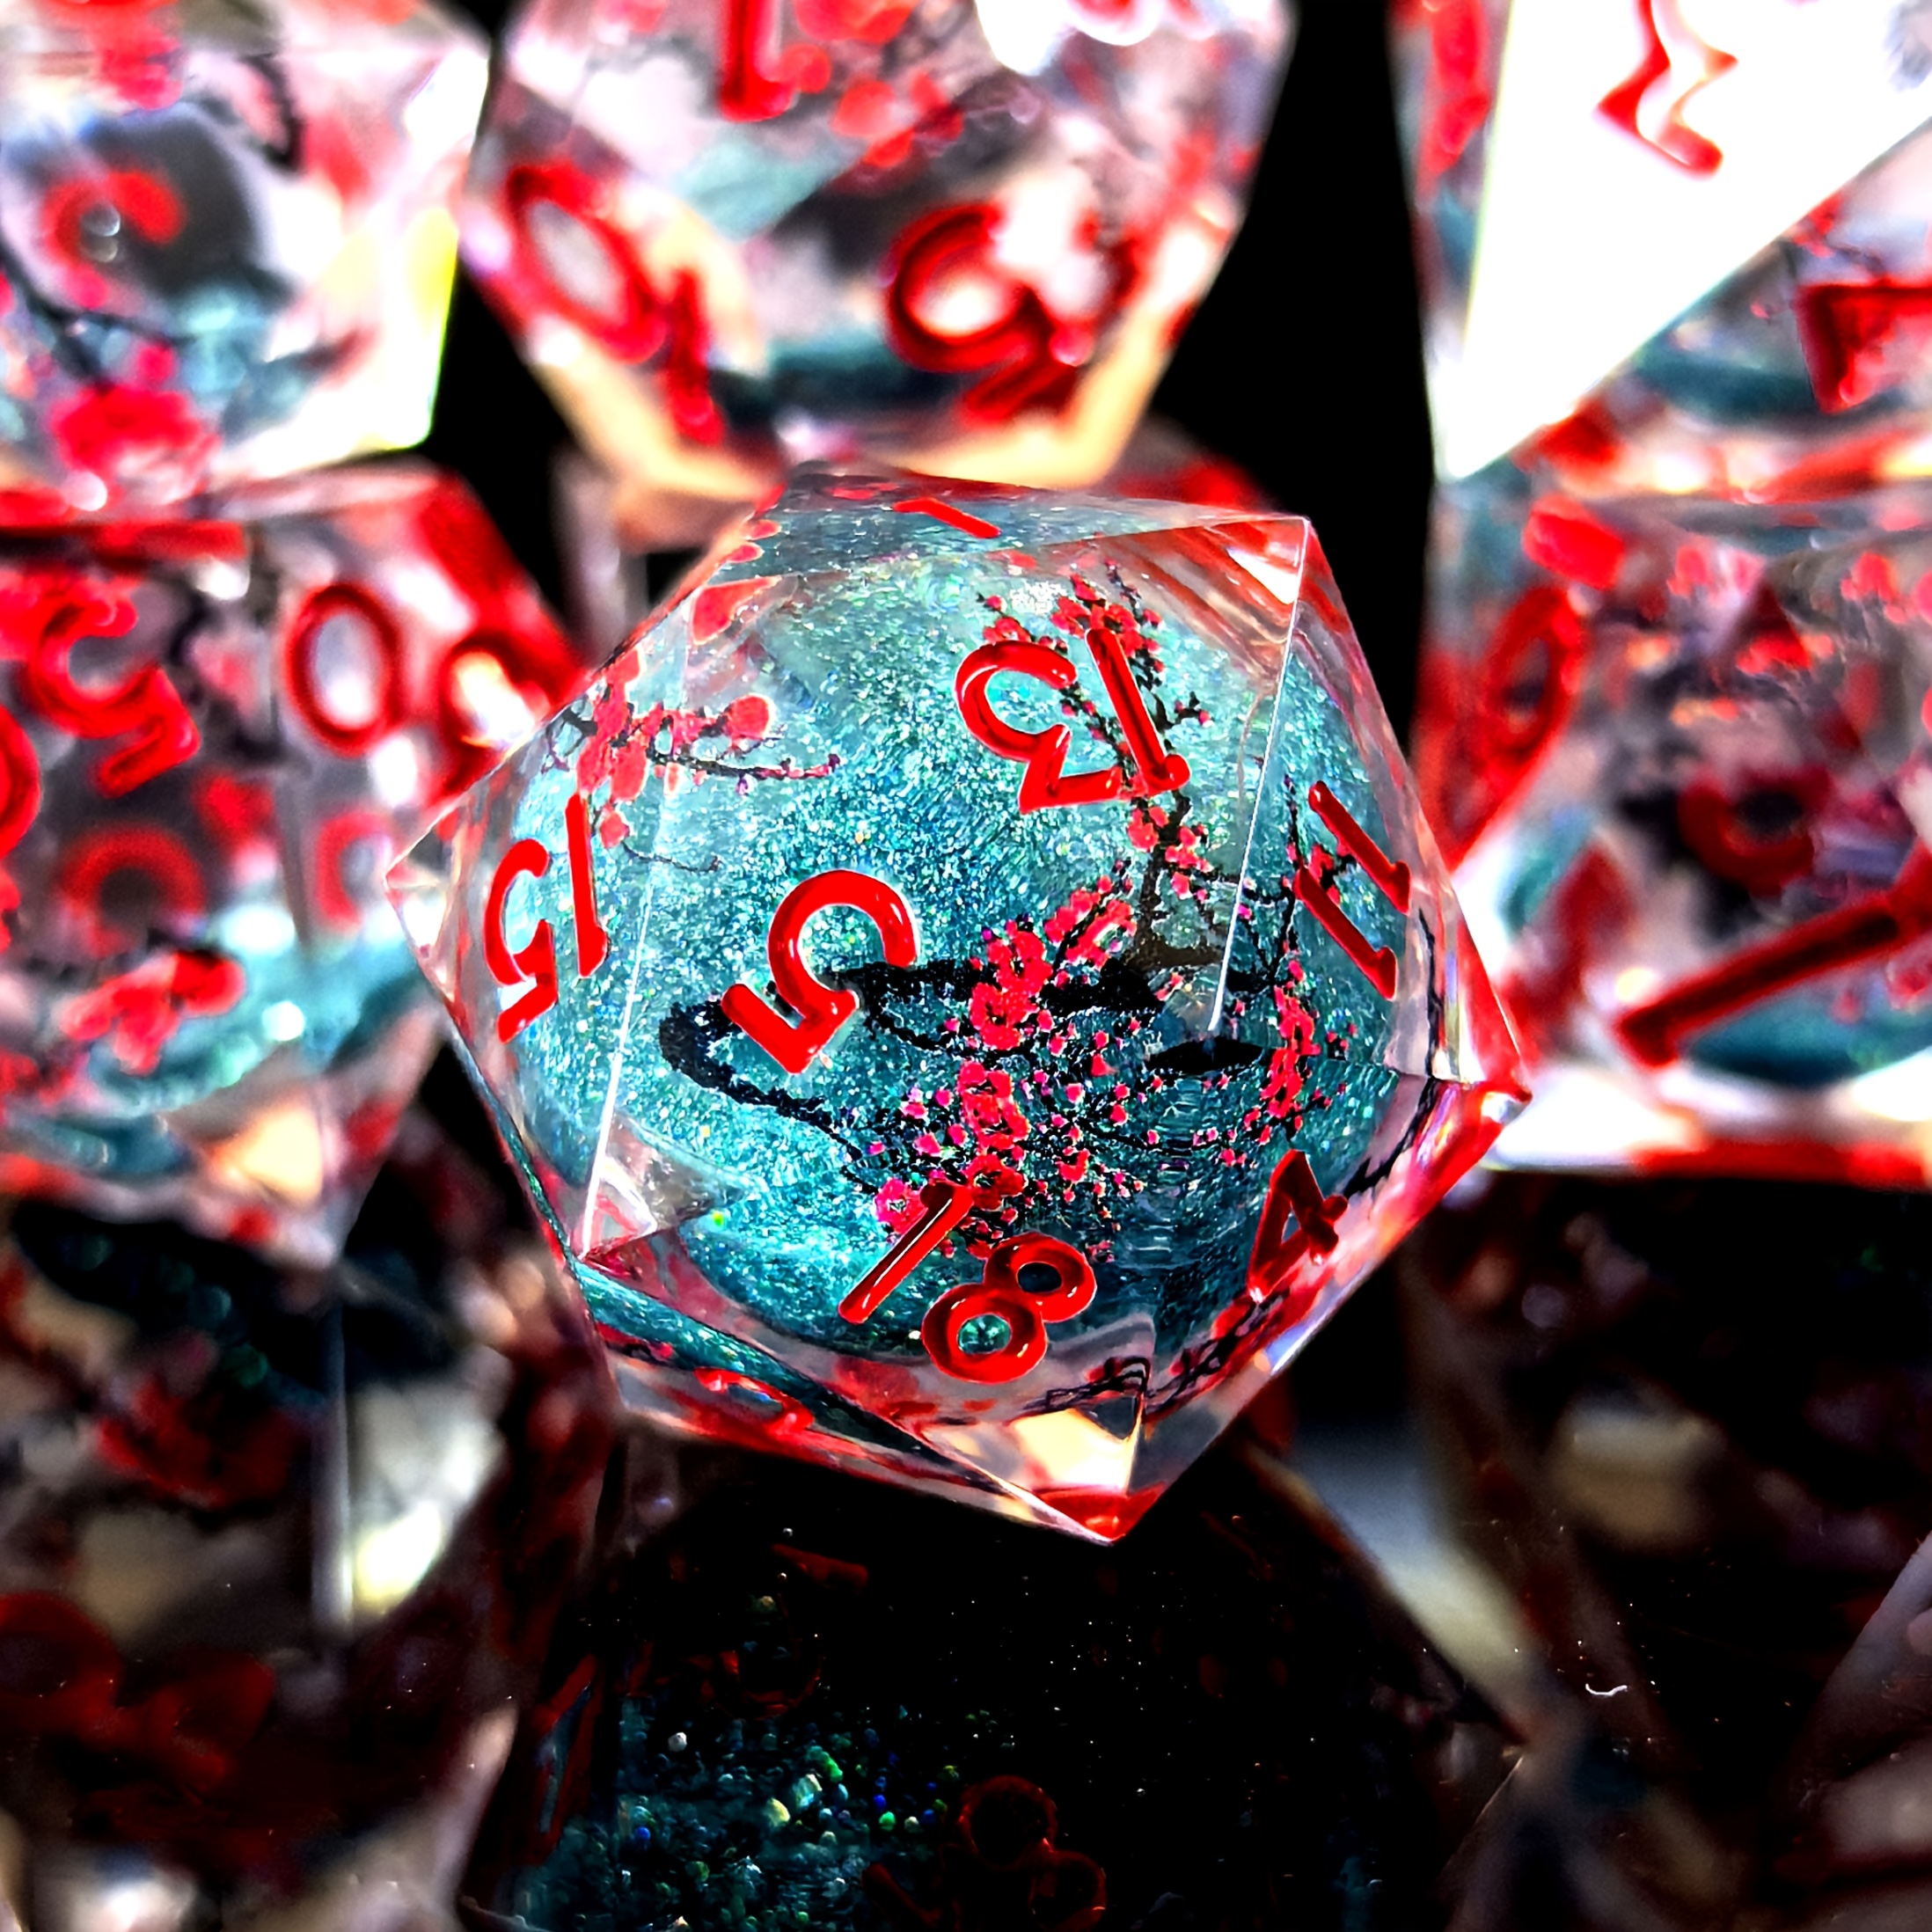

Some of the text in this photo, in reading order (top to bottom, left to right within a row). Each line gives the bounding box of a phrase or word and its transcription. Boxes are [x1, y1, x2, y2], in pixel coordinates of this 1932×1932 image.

[955, 630, 1189, 812] 13
[484, 793, 609, 1043] 15
[721, 869, 918, 1073] 5
[1293, 781, 1412, 1000] 11
[838, 1183, 1097, 1383] 18
[1246, 1149, 1348, 1304] 4
